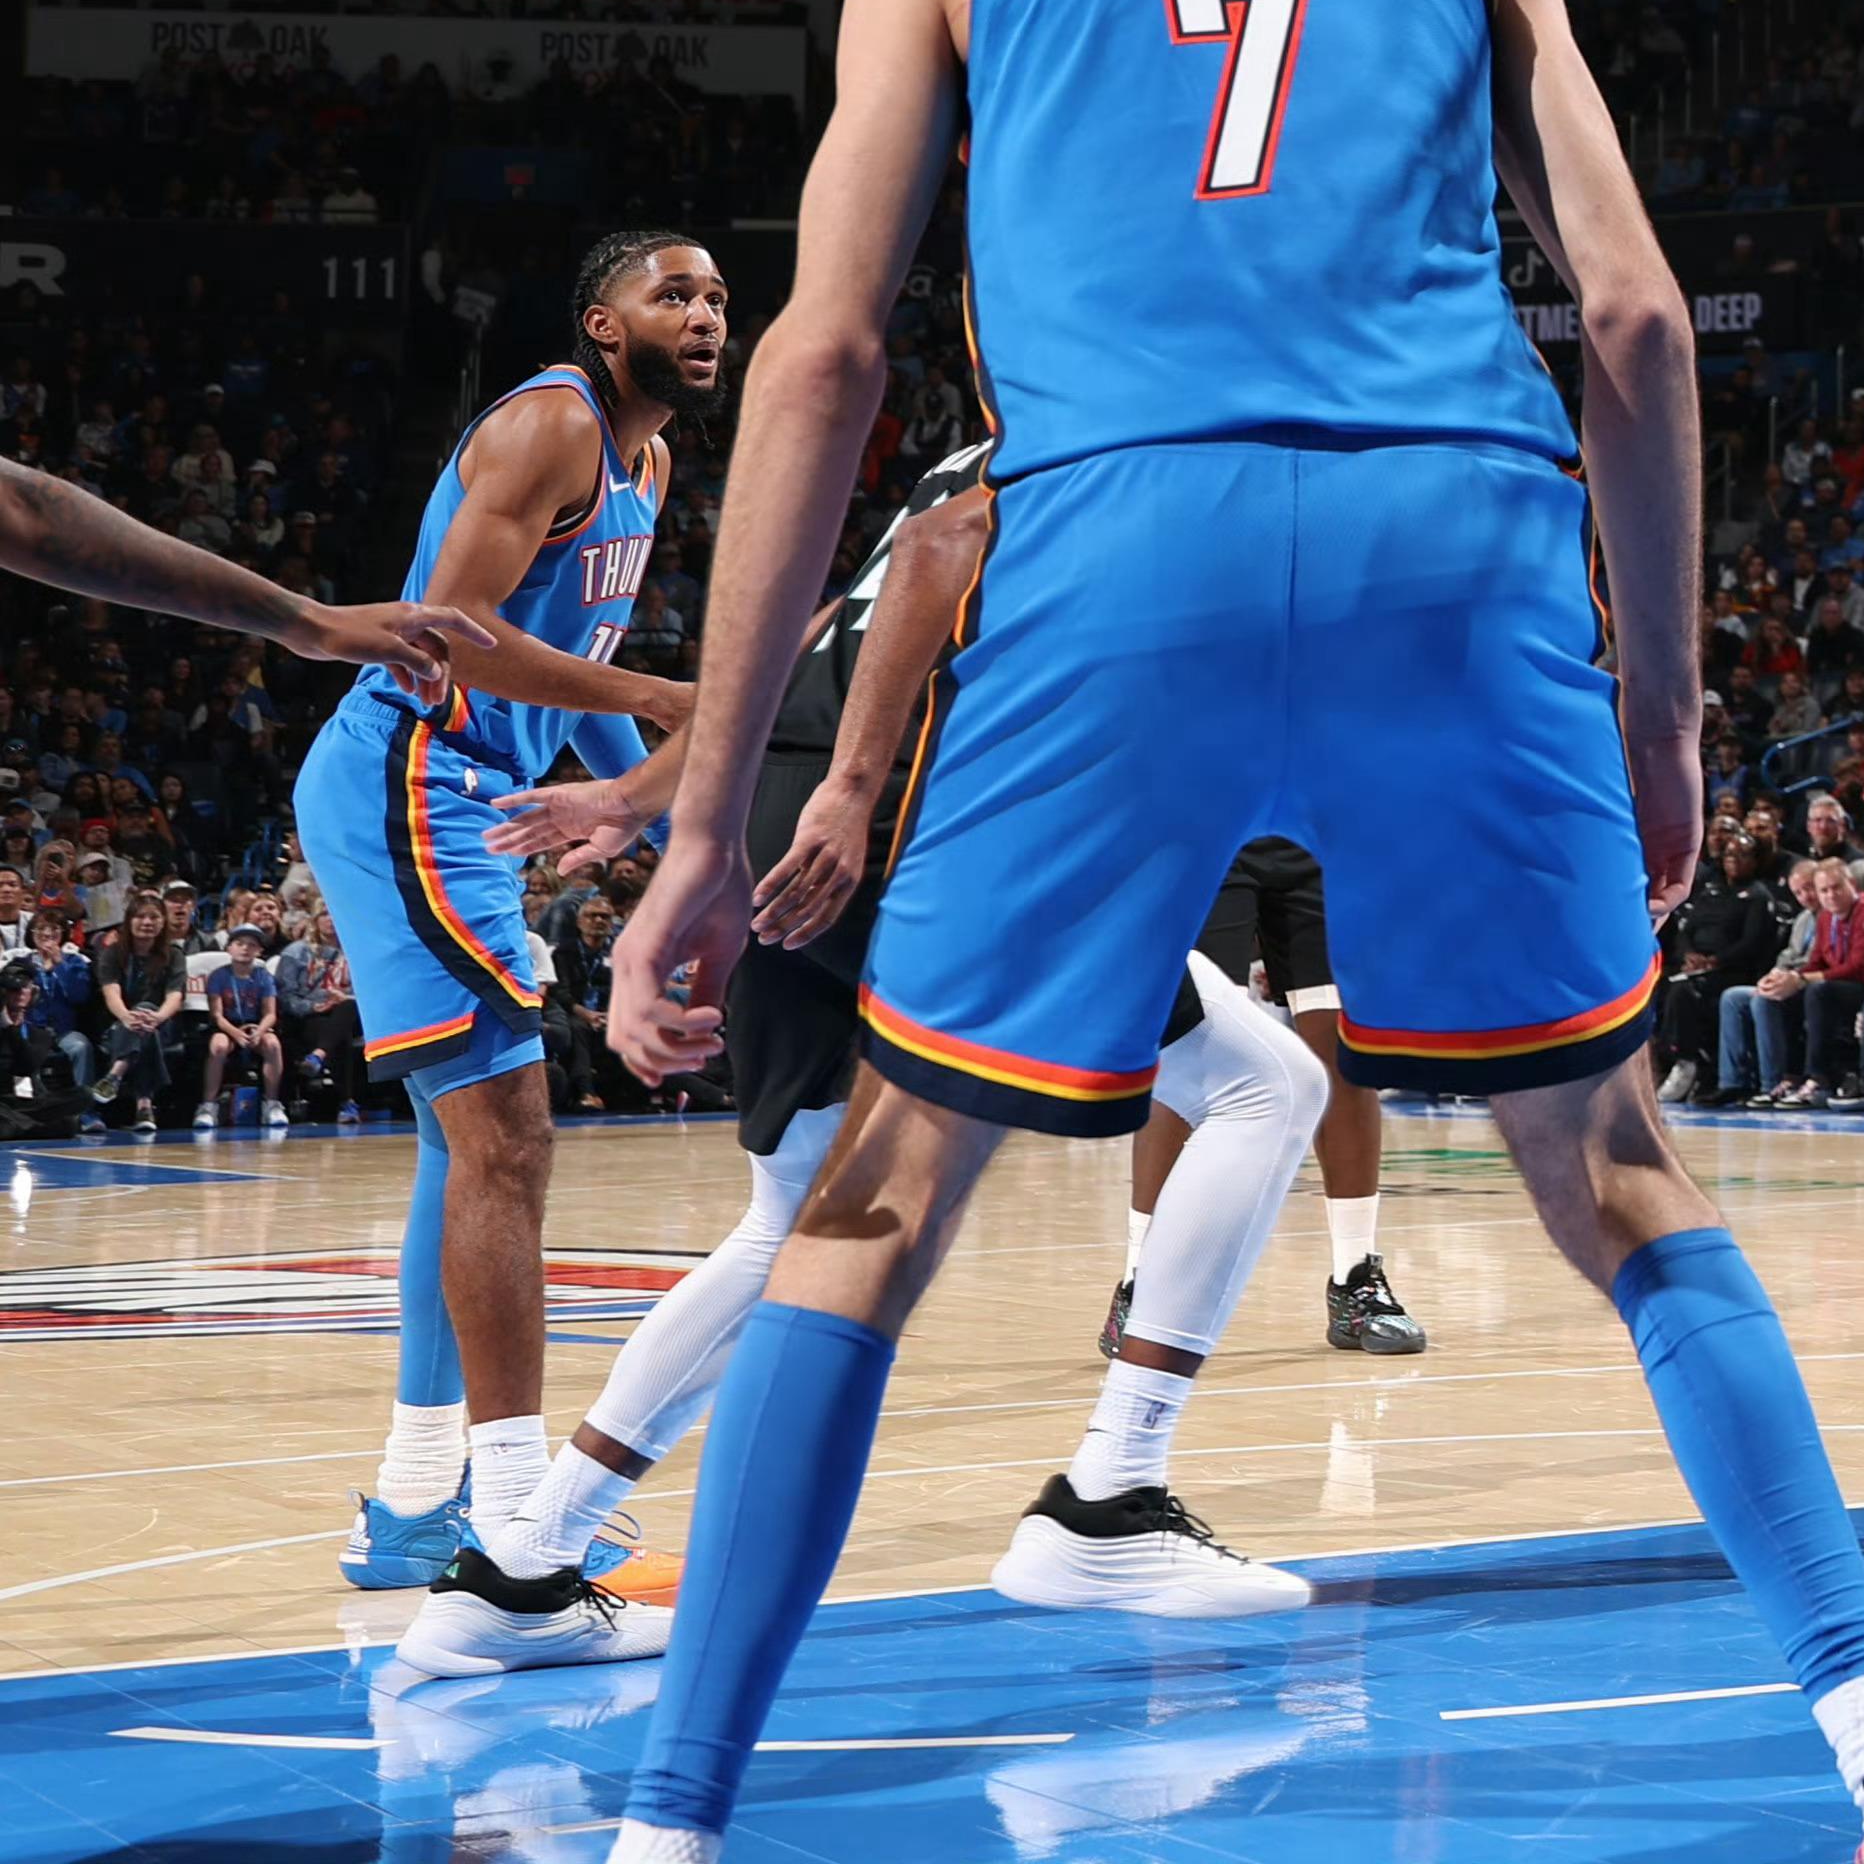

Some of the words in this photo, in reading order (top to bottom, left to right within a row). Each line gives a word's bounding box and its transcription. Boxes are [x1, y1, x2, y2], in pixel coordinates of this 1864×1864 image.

[152, 20, 222, 52] POST
[271, 25, 329, 57] OAK
[540, 29, 609, 63] POST
[654, 34, 708, 68] OAK
[322, 256, 396, 300] 111
[1695, 291, 1764, 333] DEEP
